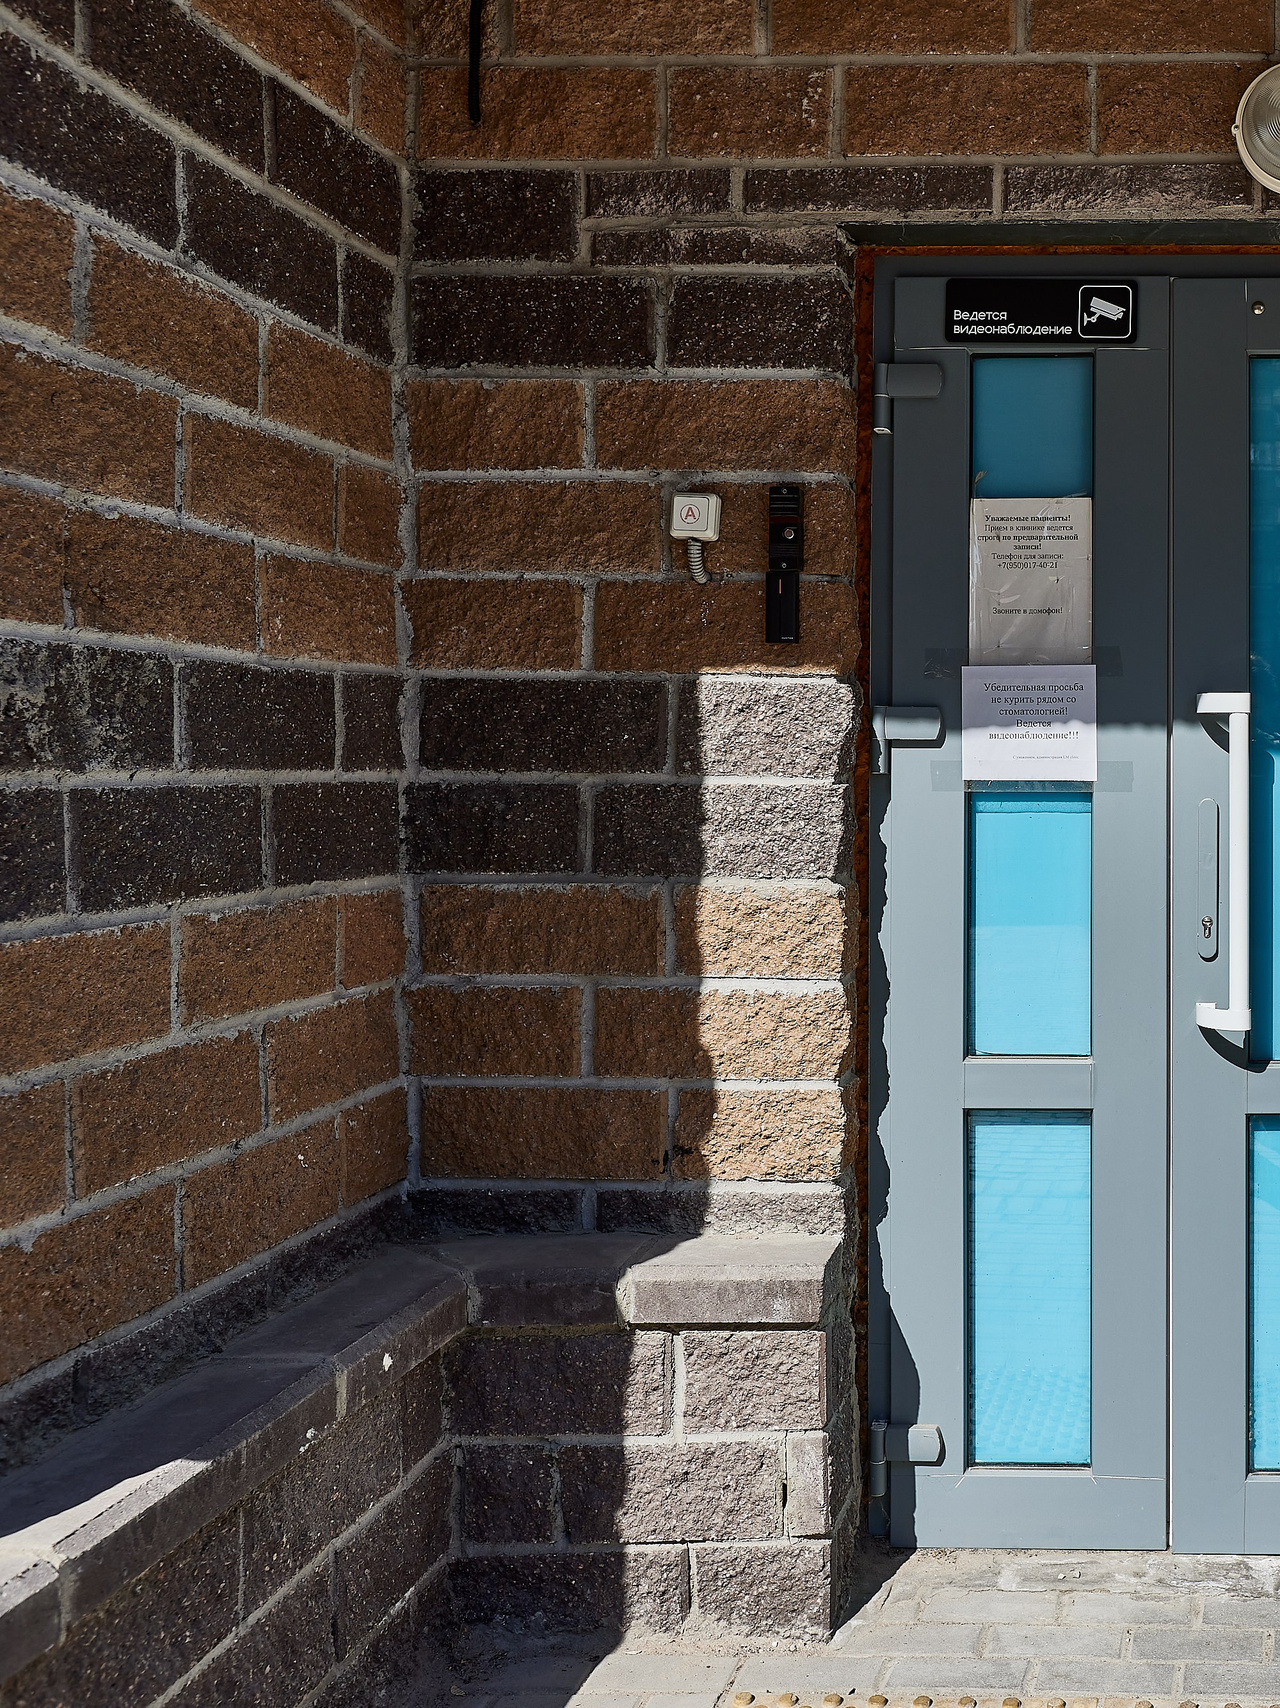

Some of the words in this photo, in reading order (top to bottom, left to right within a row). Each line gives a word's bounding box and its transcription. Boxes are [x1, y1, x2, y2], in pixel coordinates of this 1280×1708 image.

[953, 309, 1007, 321] Ведется
[953, 323, 1073, 335] видеонаблюдение
[1013, 534, 1079, 543] предварительной
[991, 552, 1022, 561] Телефон
[1028, 607, 1063, 615] домофон!
[983, 682, 1046, 693] Убедительная
[1048, 682, 1084, 693] просьба
[1004, 696, 1034, 705] курить
[1036, 696, 1064, 705] рядом
[999, 707, 1068, 715] стоматологией!
[1016, 719, 1052, 728] Ведется
[988, 731, 1079, 740] видеонаблюдение!!!
